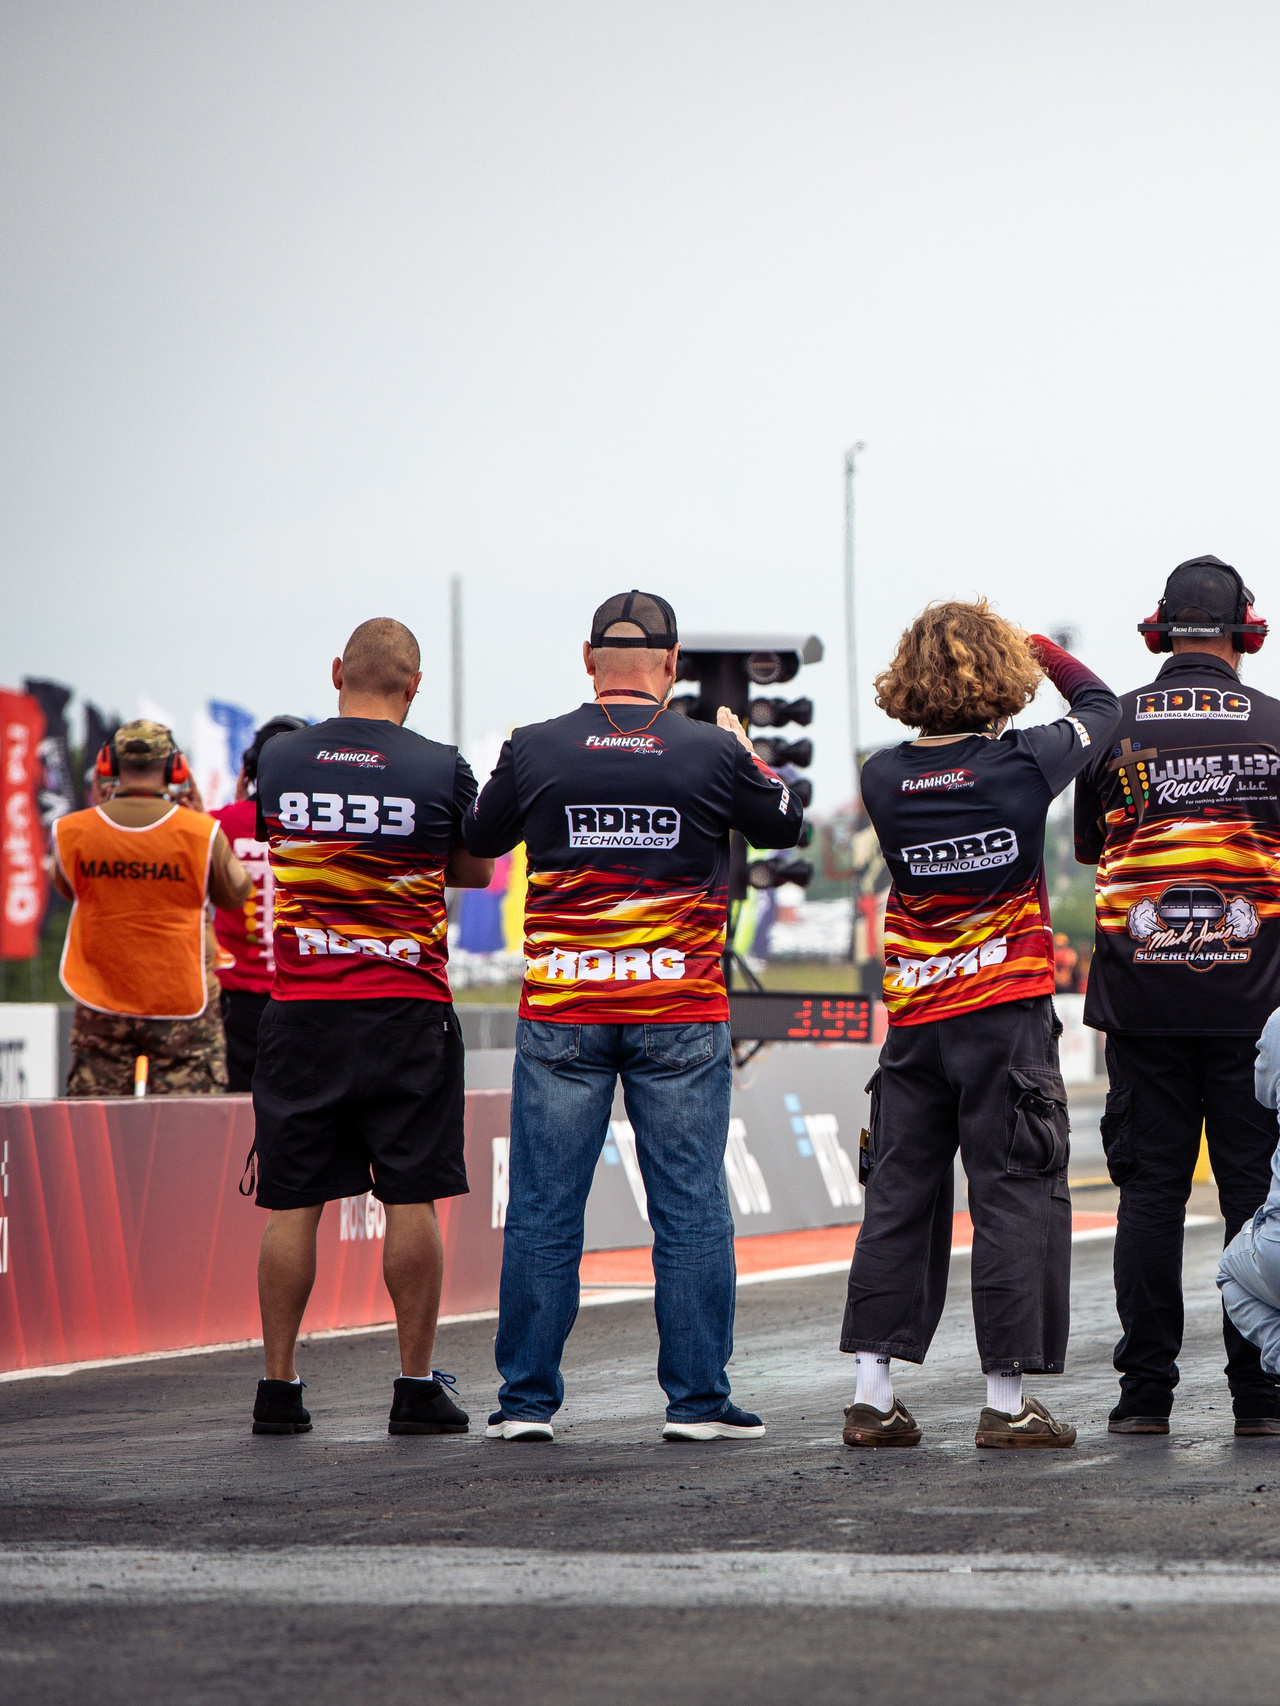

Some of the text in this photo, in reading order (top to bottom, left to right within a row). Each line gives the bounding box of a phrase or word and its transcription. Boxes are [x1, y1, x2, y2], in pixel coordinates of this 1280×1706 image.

[1138, 689, 1250, 713] RDRC
[1137, 712, 1163, 720] RUSSIAN
[585, 735, 655, 748] FLAMHOLC
[316, 750, 379, 763] FLAMHOLC
[1148, 755, 1224, 784] LUKE
[901, 771, 965, 792] FLAMHOLC
[1155, 773, 1236, 805] Racing
[278, 792, 416, 837] 8333
[568, 807, 678, 834] RDRC
[572, 835, 675, 847] TECHNOLOGY
[904, 830, 1014, 863] RDRC
[80, 859, 186, 882] MARSHAL
[912, 852, 1015, 873] TECHNOLOGY
[546, 947, 686, 980] RDRC
[1136, 951, 1248, 961] SUPERCHARGERS
